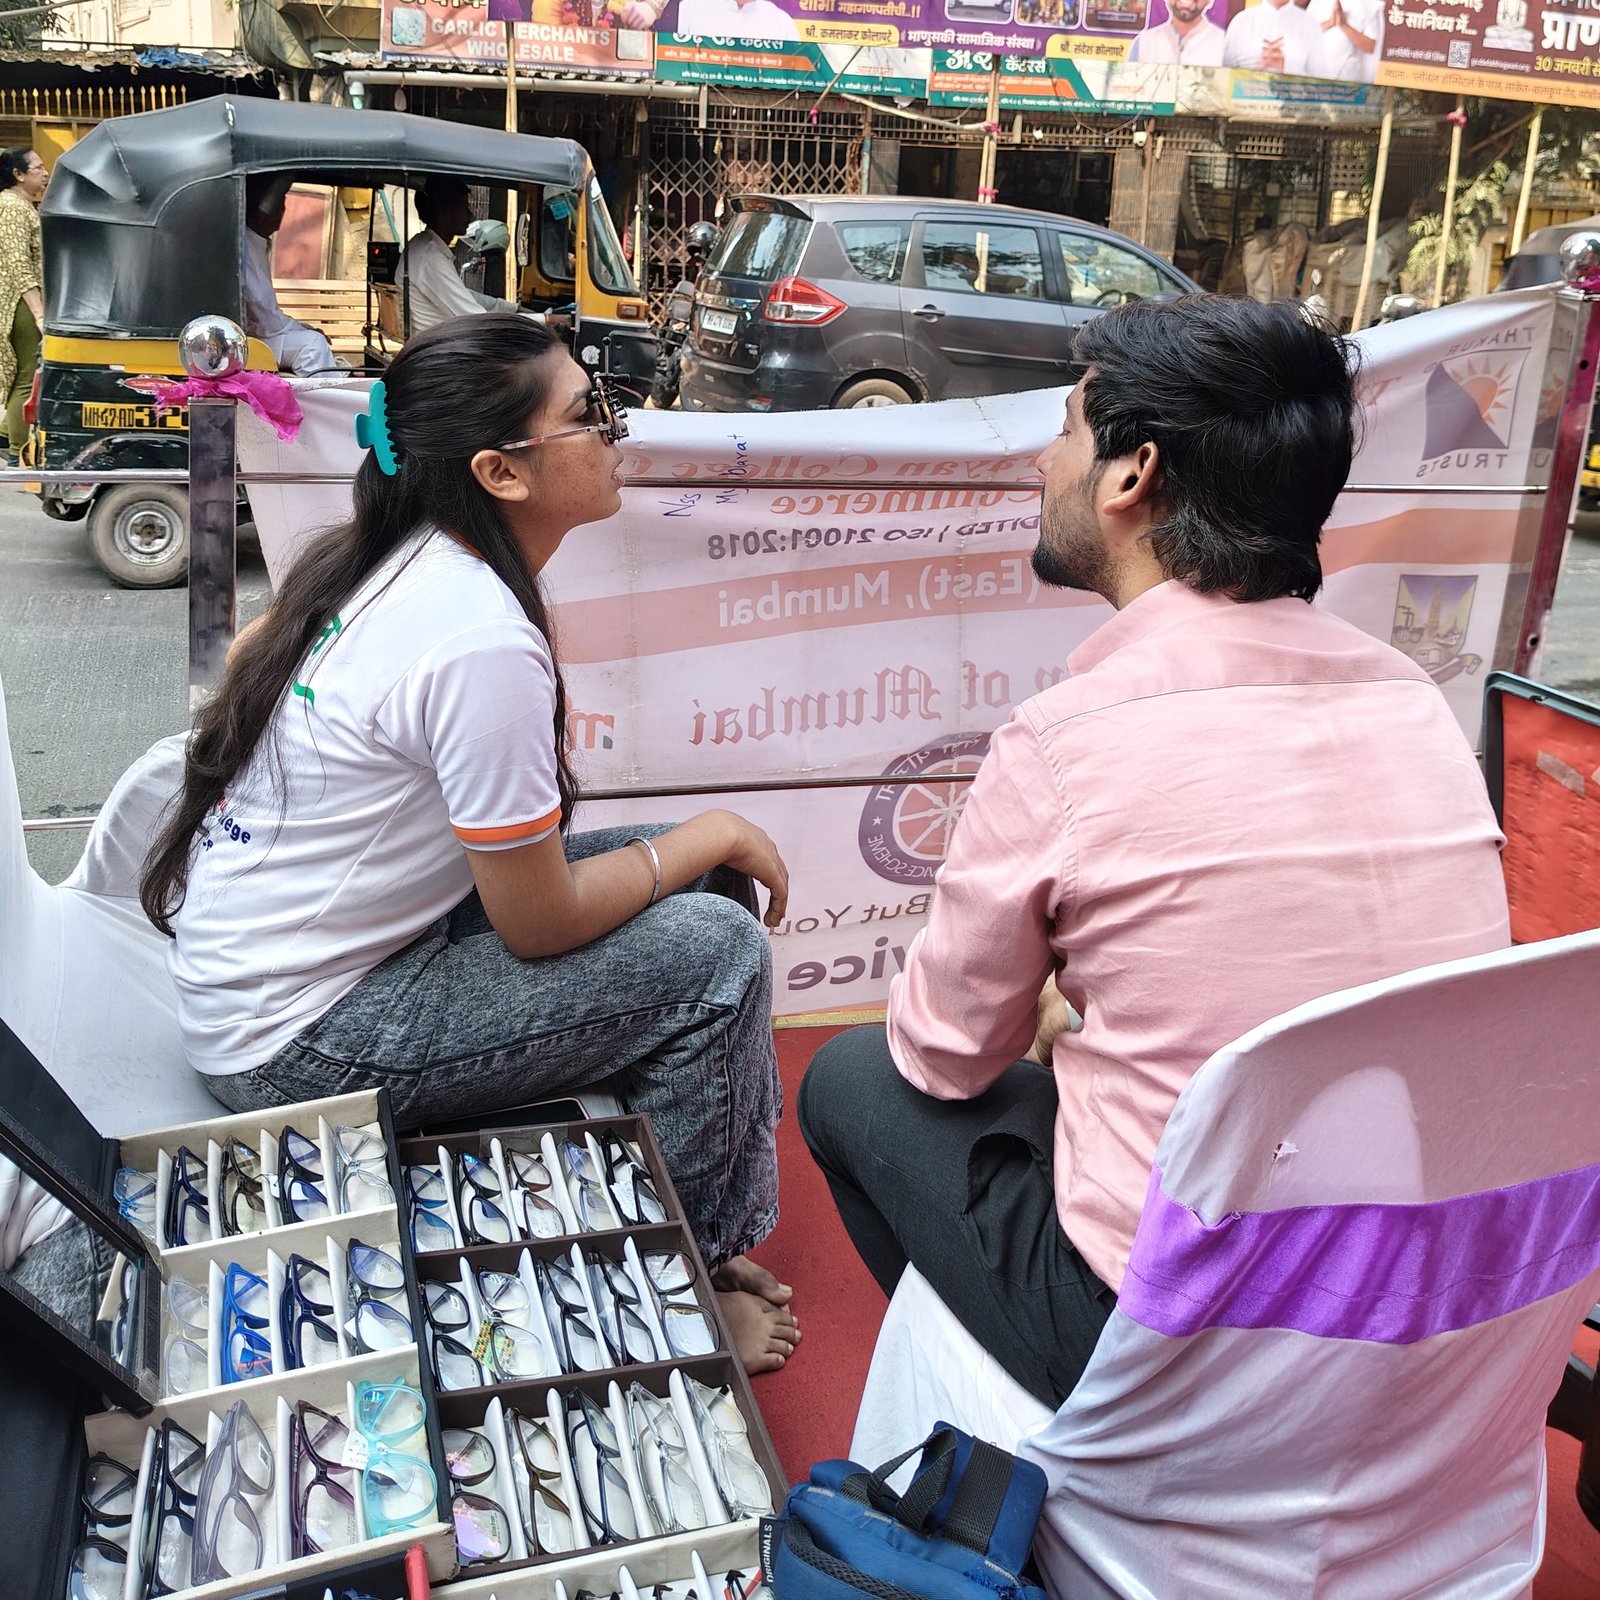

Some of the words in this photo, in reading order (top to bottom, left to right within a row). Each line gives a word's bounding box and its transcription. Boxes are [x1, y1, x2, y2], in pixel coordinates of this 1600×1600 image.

[431, 18, 497, 37] GARLIC
[466, 39, 575, 62] WHOESALE
[1534, 55, 1553, 72] 30
[763, 1523, 774, 1583] ORIGINALS
